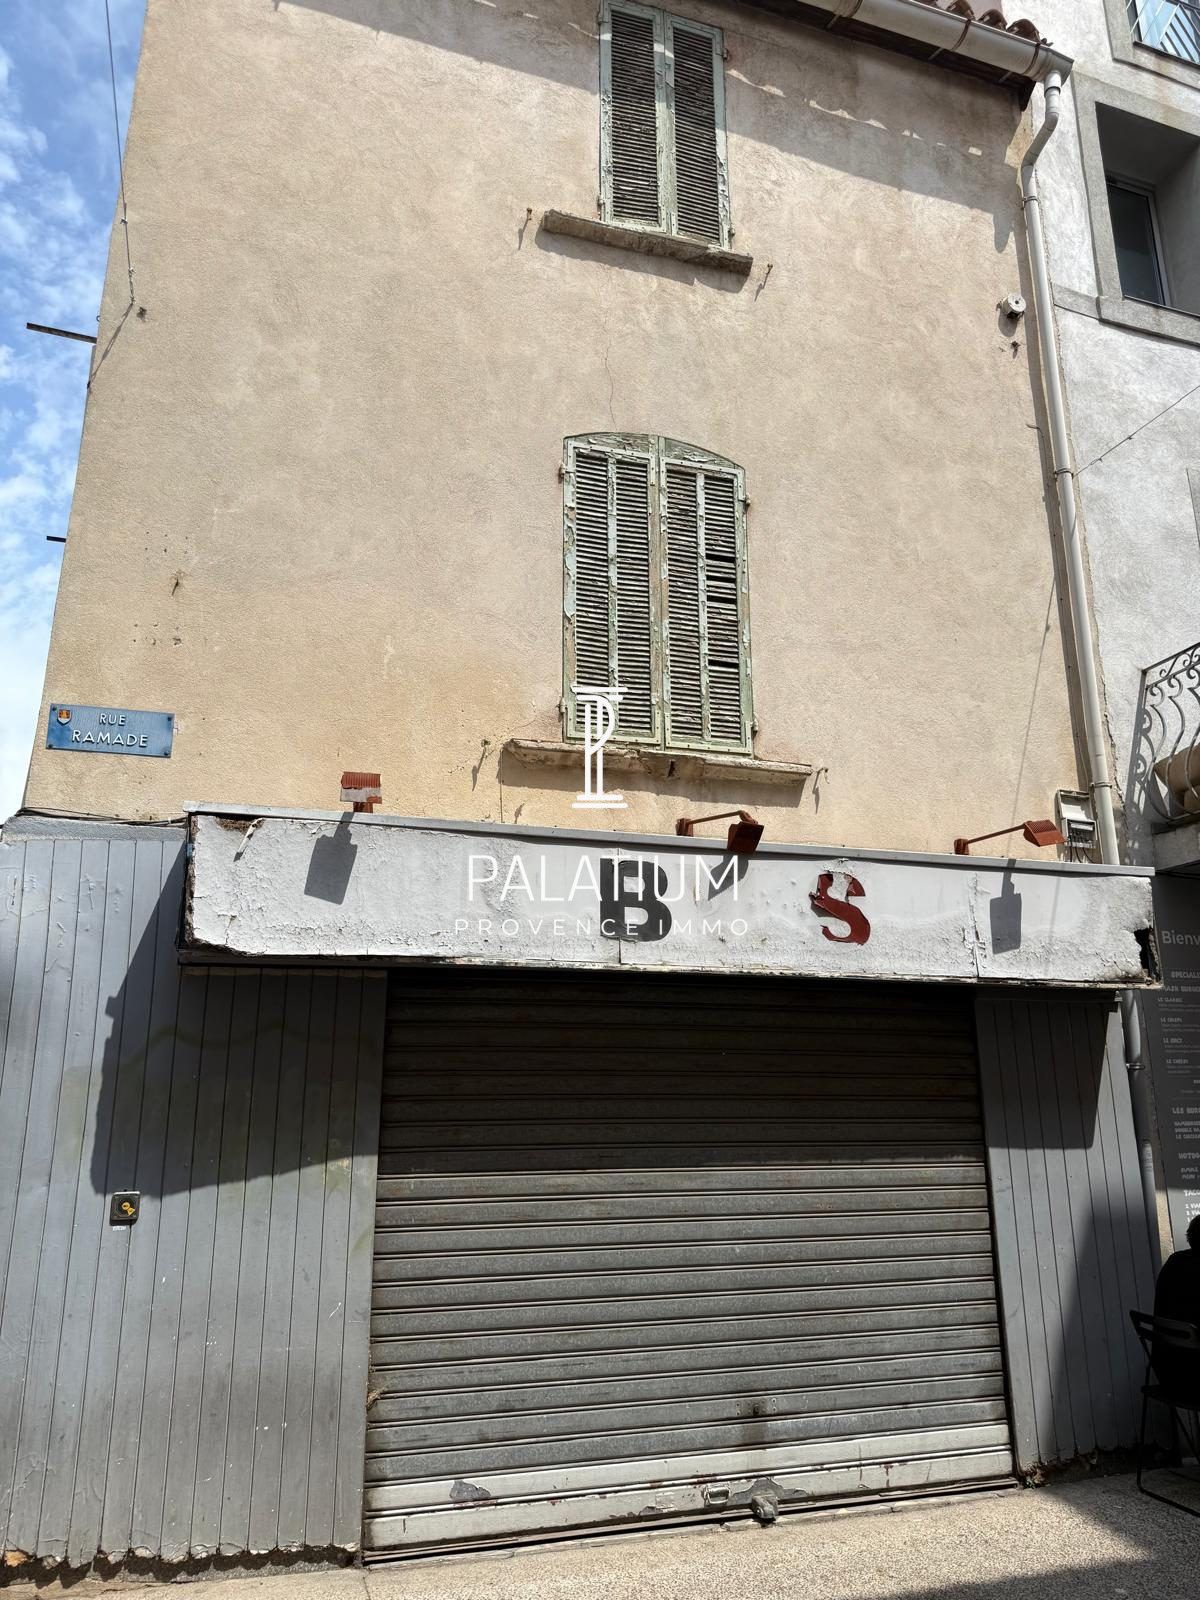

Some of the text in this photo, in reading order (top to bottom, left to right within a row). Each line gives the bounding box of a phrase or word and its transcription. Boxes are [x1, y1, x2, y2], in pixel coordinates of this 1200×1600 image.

[99, 713, 127, 726] RUE
[71, 729, 149, 748] RAMADE
[600, 856, 871, 946] B S
